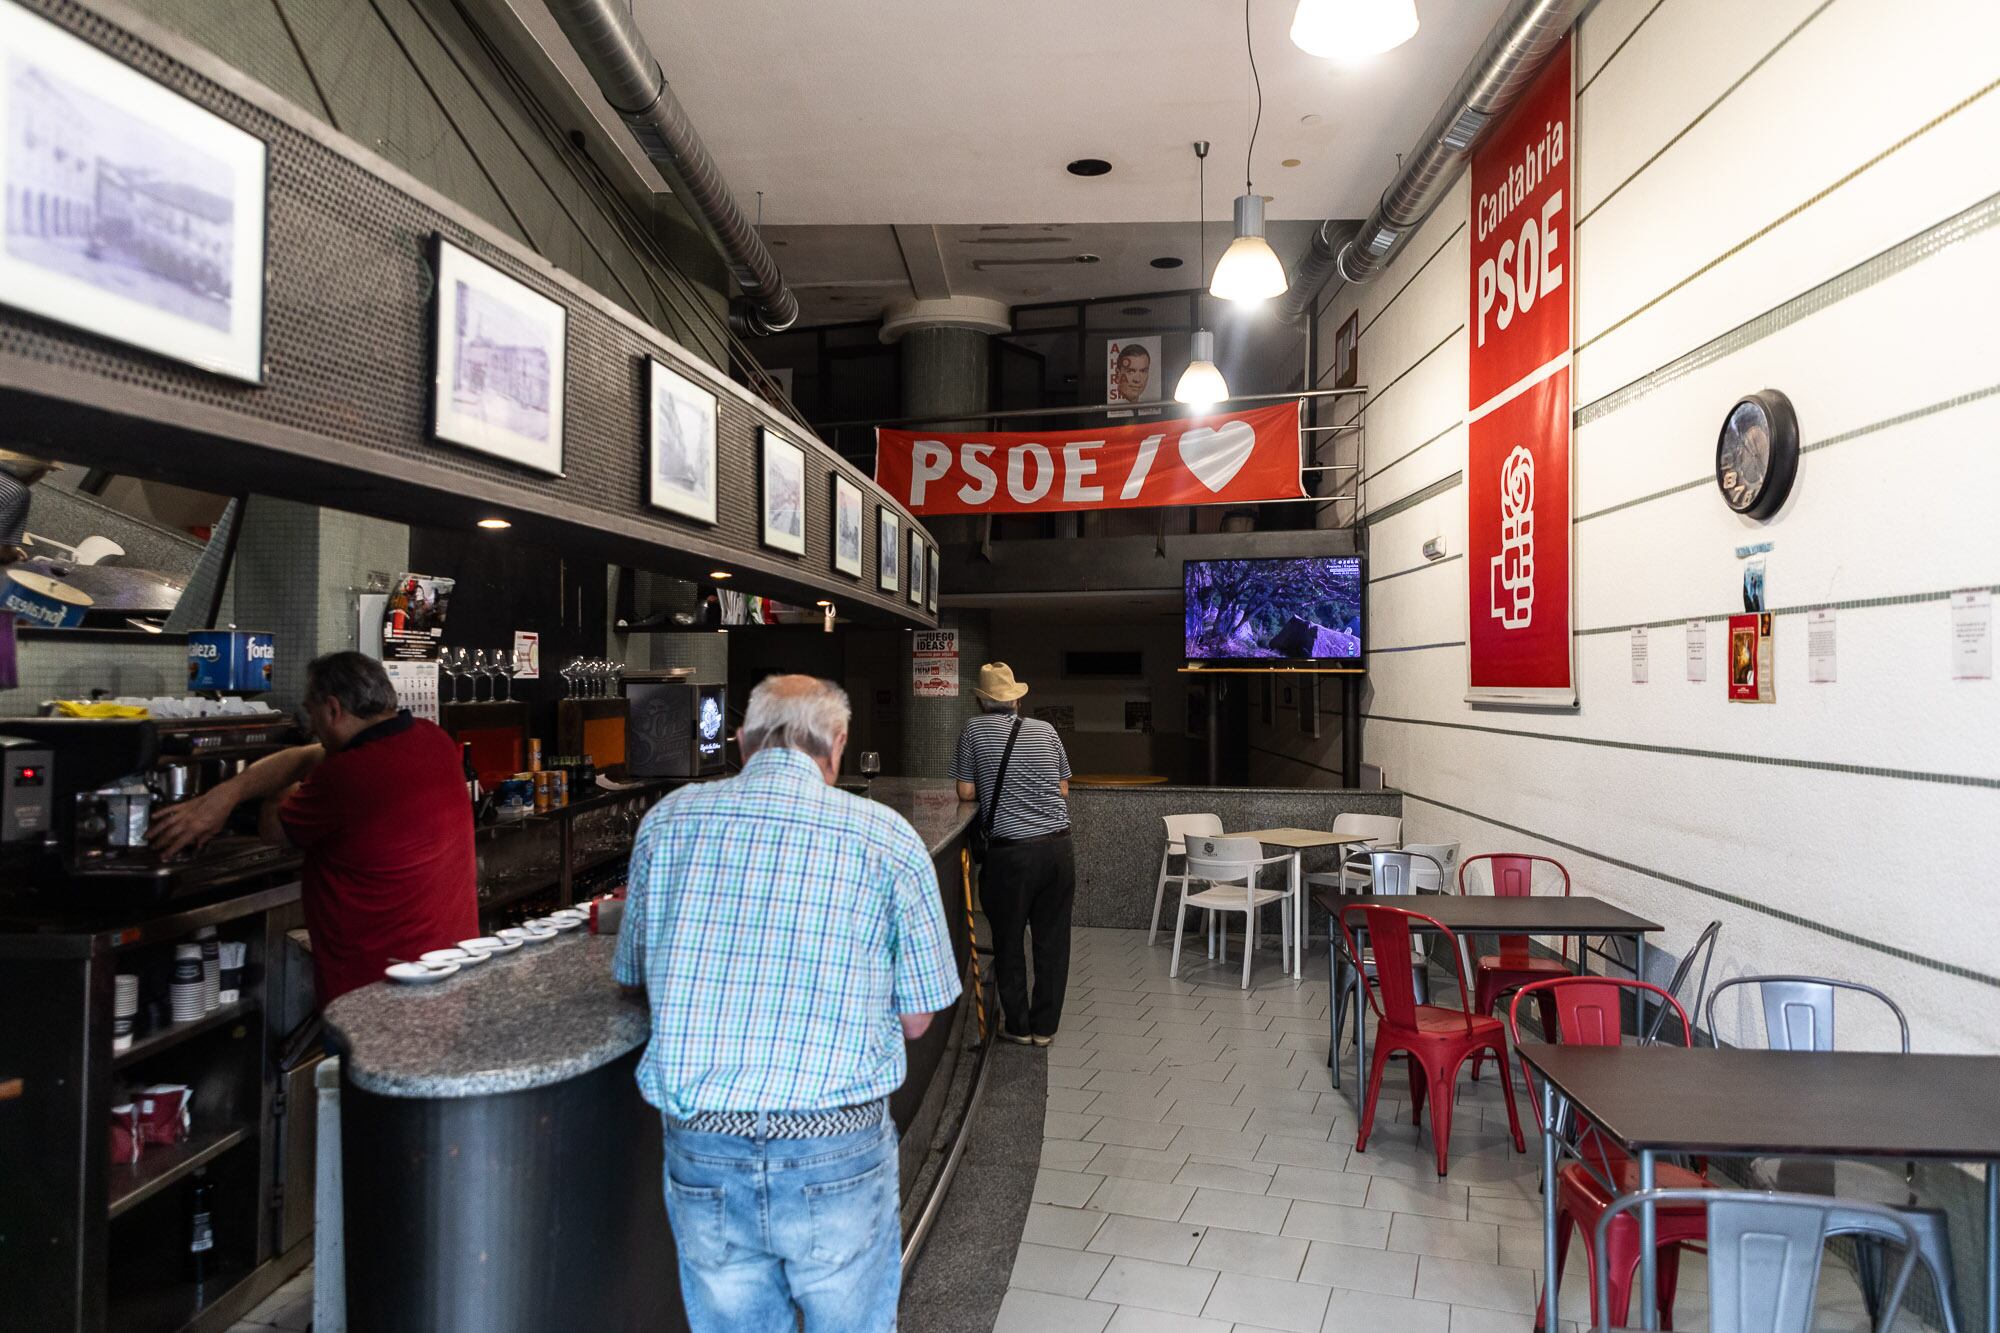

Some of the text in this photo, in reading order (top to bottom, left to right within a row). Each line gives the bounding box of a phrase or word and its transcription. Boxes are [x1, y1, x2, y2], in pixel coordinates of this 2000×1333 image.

[1478, 121, 1563, 242] Cantabria
[1478, 189, 1563, 348] PSOE
[909, 440, 1106, 506] PSOE
[1723, 471, 1738, 489] 8
[1732, 484, 1746, 502] 7
[917, 641, 945, 650] IDEAS
[922, 632, 954, 641] JUEGO
[1348, 641, 1354, 650] 2
